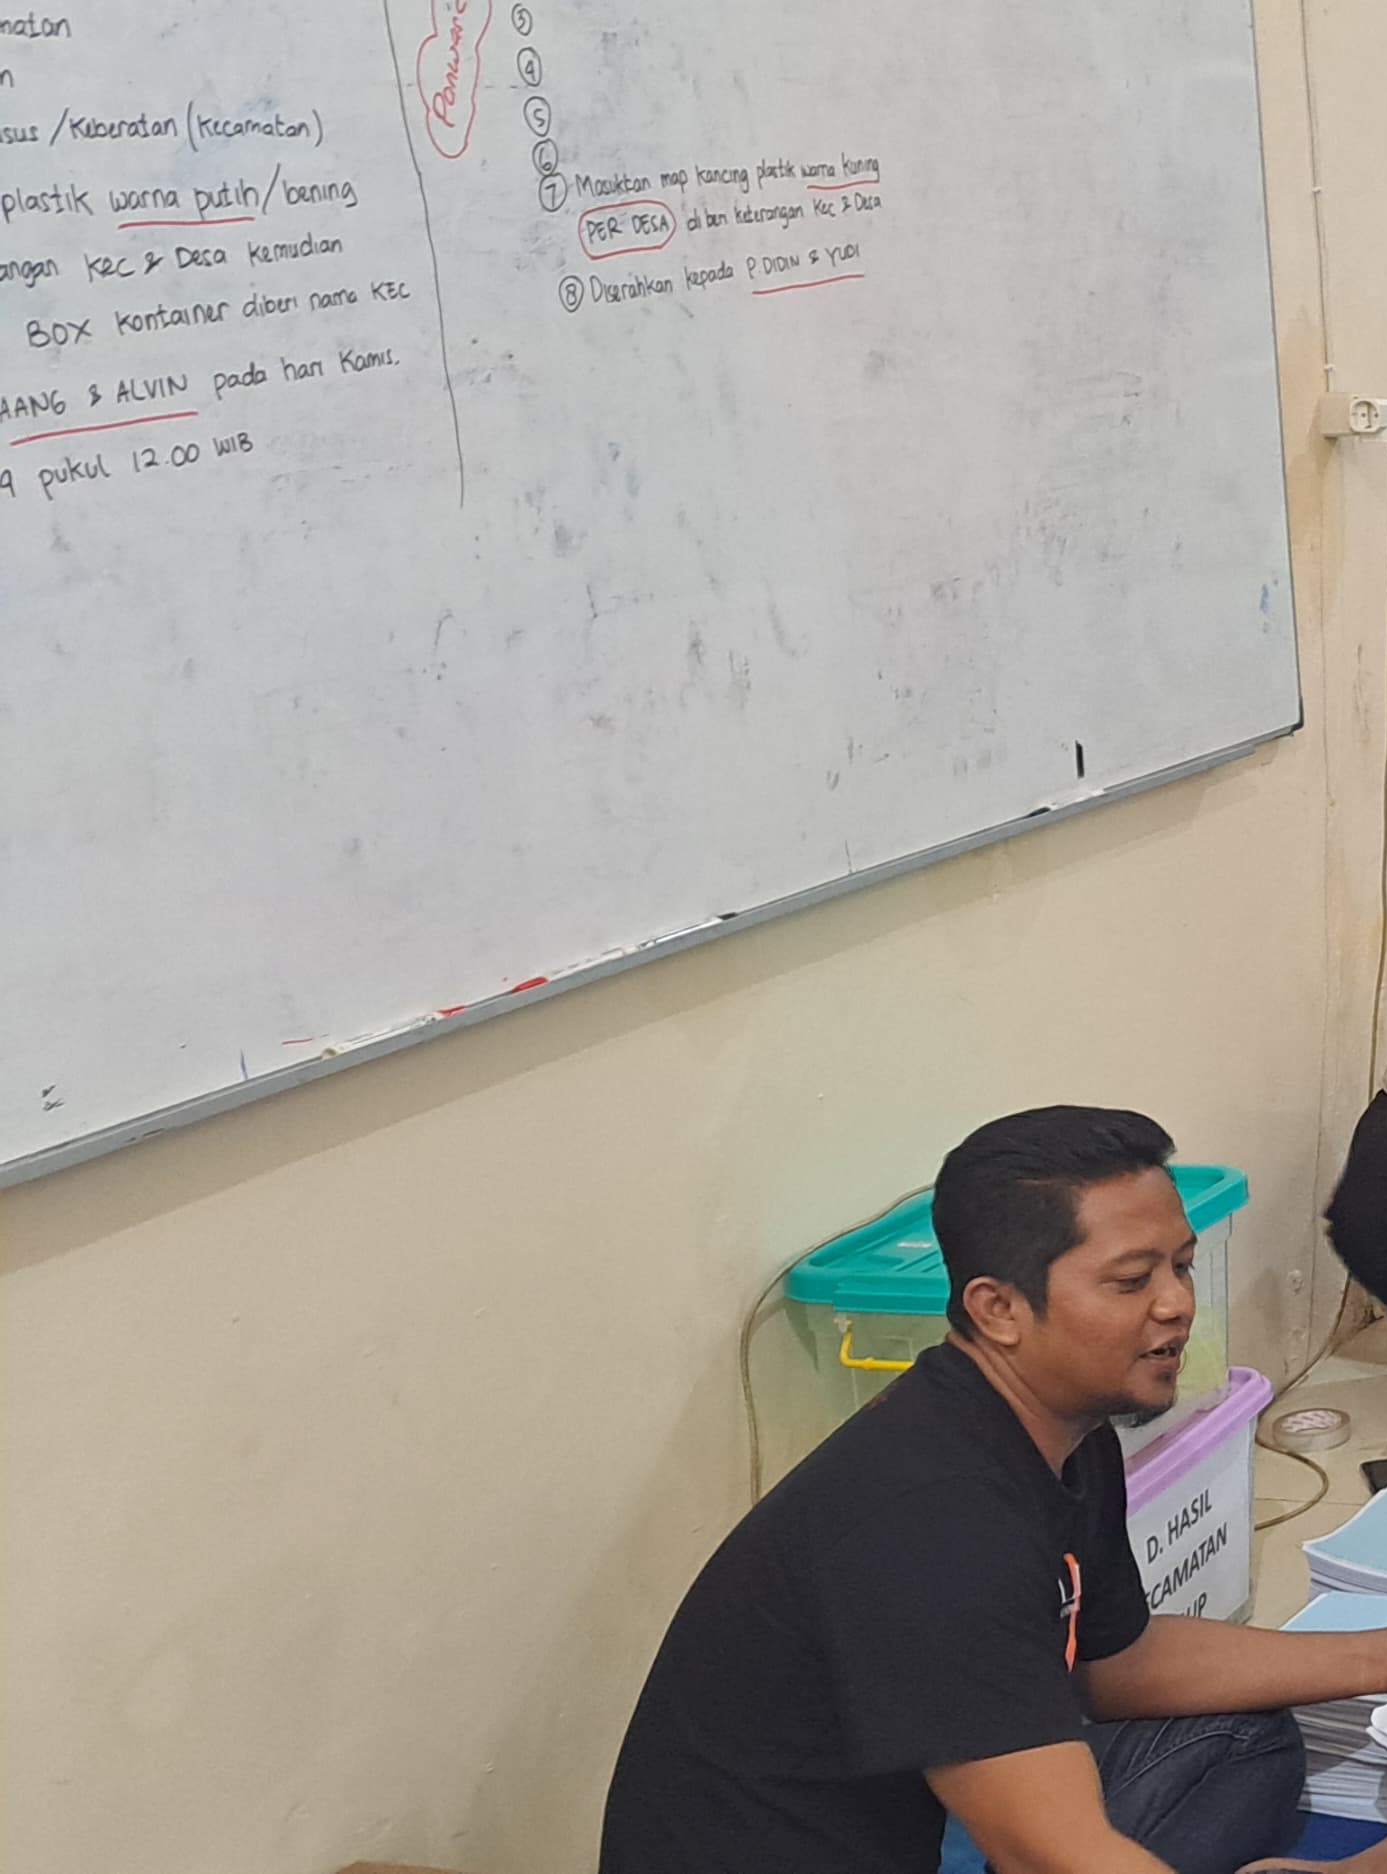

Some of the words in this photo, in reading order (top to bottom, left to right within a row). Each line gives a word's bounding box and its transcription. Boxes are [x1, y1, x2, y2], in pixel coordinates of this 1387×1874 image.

[660, 169, 688, 194] map
[109, 188, 181, 213] warna
[586, 216, 623, 244] PER
[631, 214, 670, 236] DESA
[176, 246, 227, 270] Desa
[825, 243, 860, 267] YUDI
[26, 318, 93, 348] BOX
[309, 289, 357, 311] nama
[371, 281, 411, 301] KEC
[116, 374, 189, 403] ALVIN
[213, 362, 267, 401] pada
[38, 454, 111, 501] pukul
[132, 443, 201, 473] 12.00
[213, 432, 254, 457] WIB
[1147, 1535, 1164, 1564] D.
[1168, 1488, 1212, 1546] HASIL
[1145, 1521, 1227, 1610] CAMATAN
